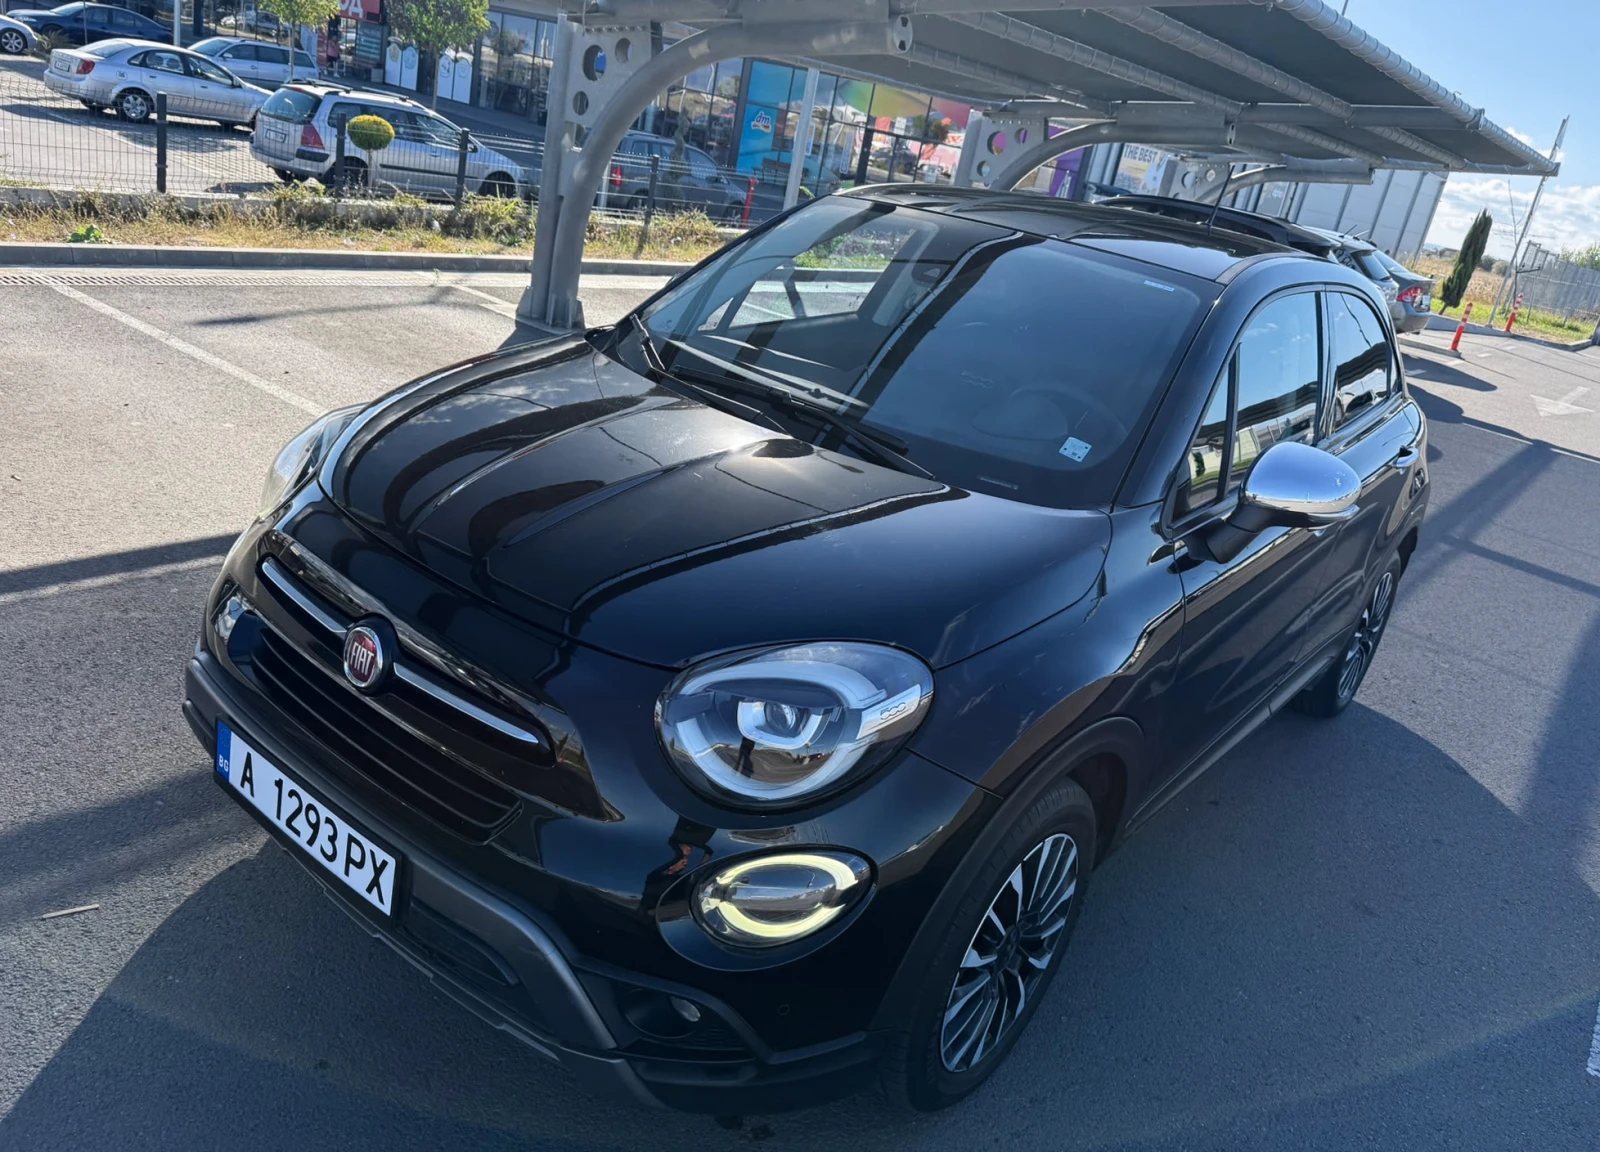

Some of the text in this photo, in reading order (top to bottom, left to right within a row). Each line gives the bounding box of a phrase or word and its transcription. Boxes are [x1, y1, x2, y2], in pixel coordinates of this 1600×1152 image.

[756, 111, 770, 125] dm
[1124, 144, 1158, 163] THE BEST
[350, 641, 375, 676] FIAT
[880, 702, 906, 720] 500
[218, 755, 229, 772] BG
[240, 751, 254, 798] A
